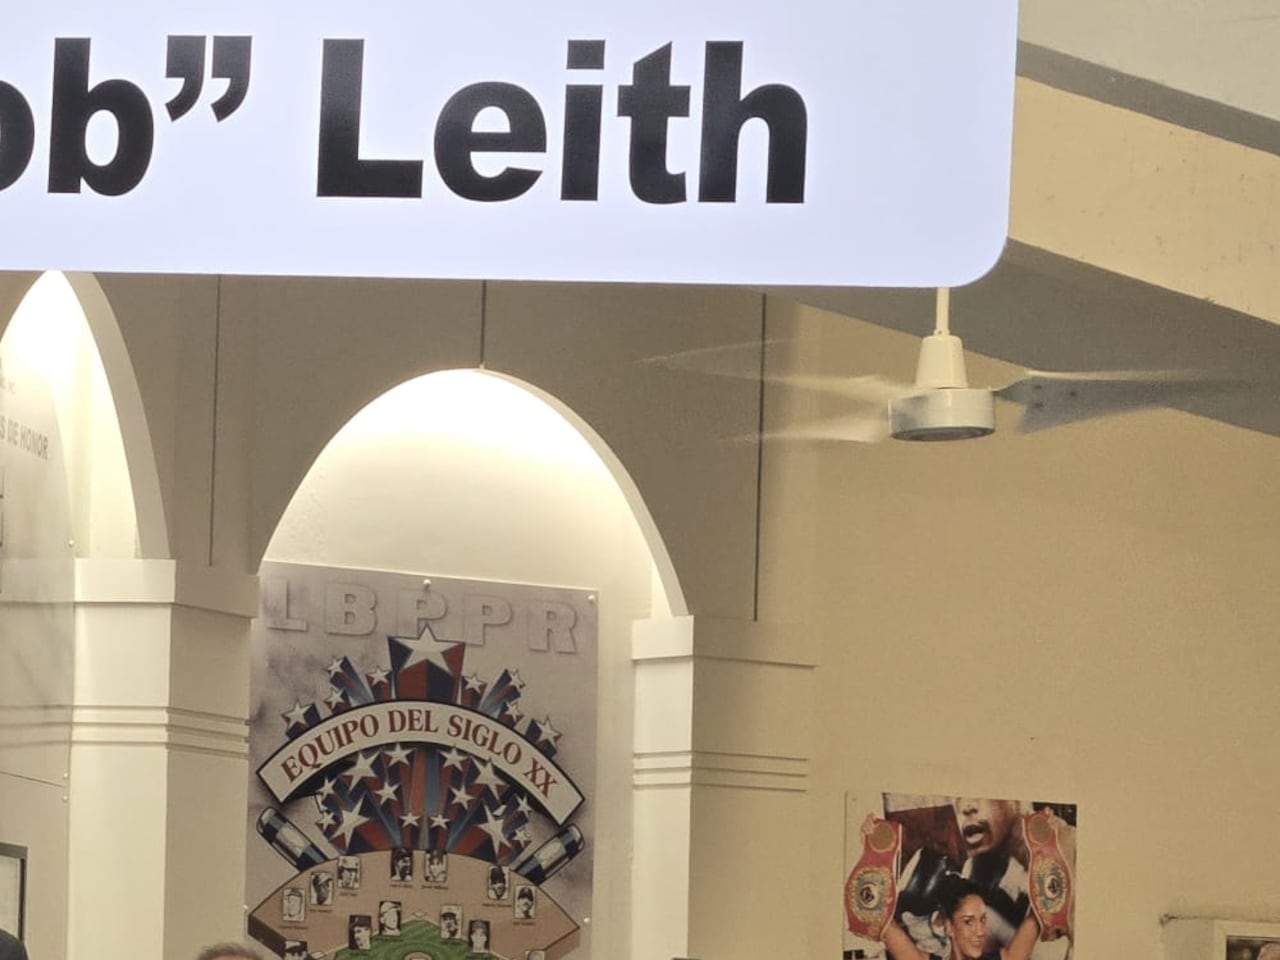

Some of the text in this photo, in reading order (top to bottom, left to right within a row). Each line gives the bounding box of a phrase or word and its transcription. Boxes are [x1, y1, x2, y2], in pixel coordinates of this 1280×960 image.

[316, 38, 808, 204] Leith
[20, 426, 48, 460] HONOR
[280, 708, 559, 798] EQUIPO DEL SIGLO XX
